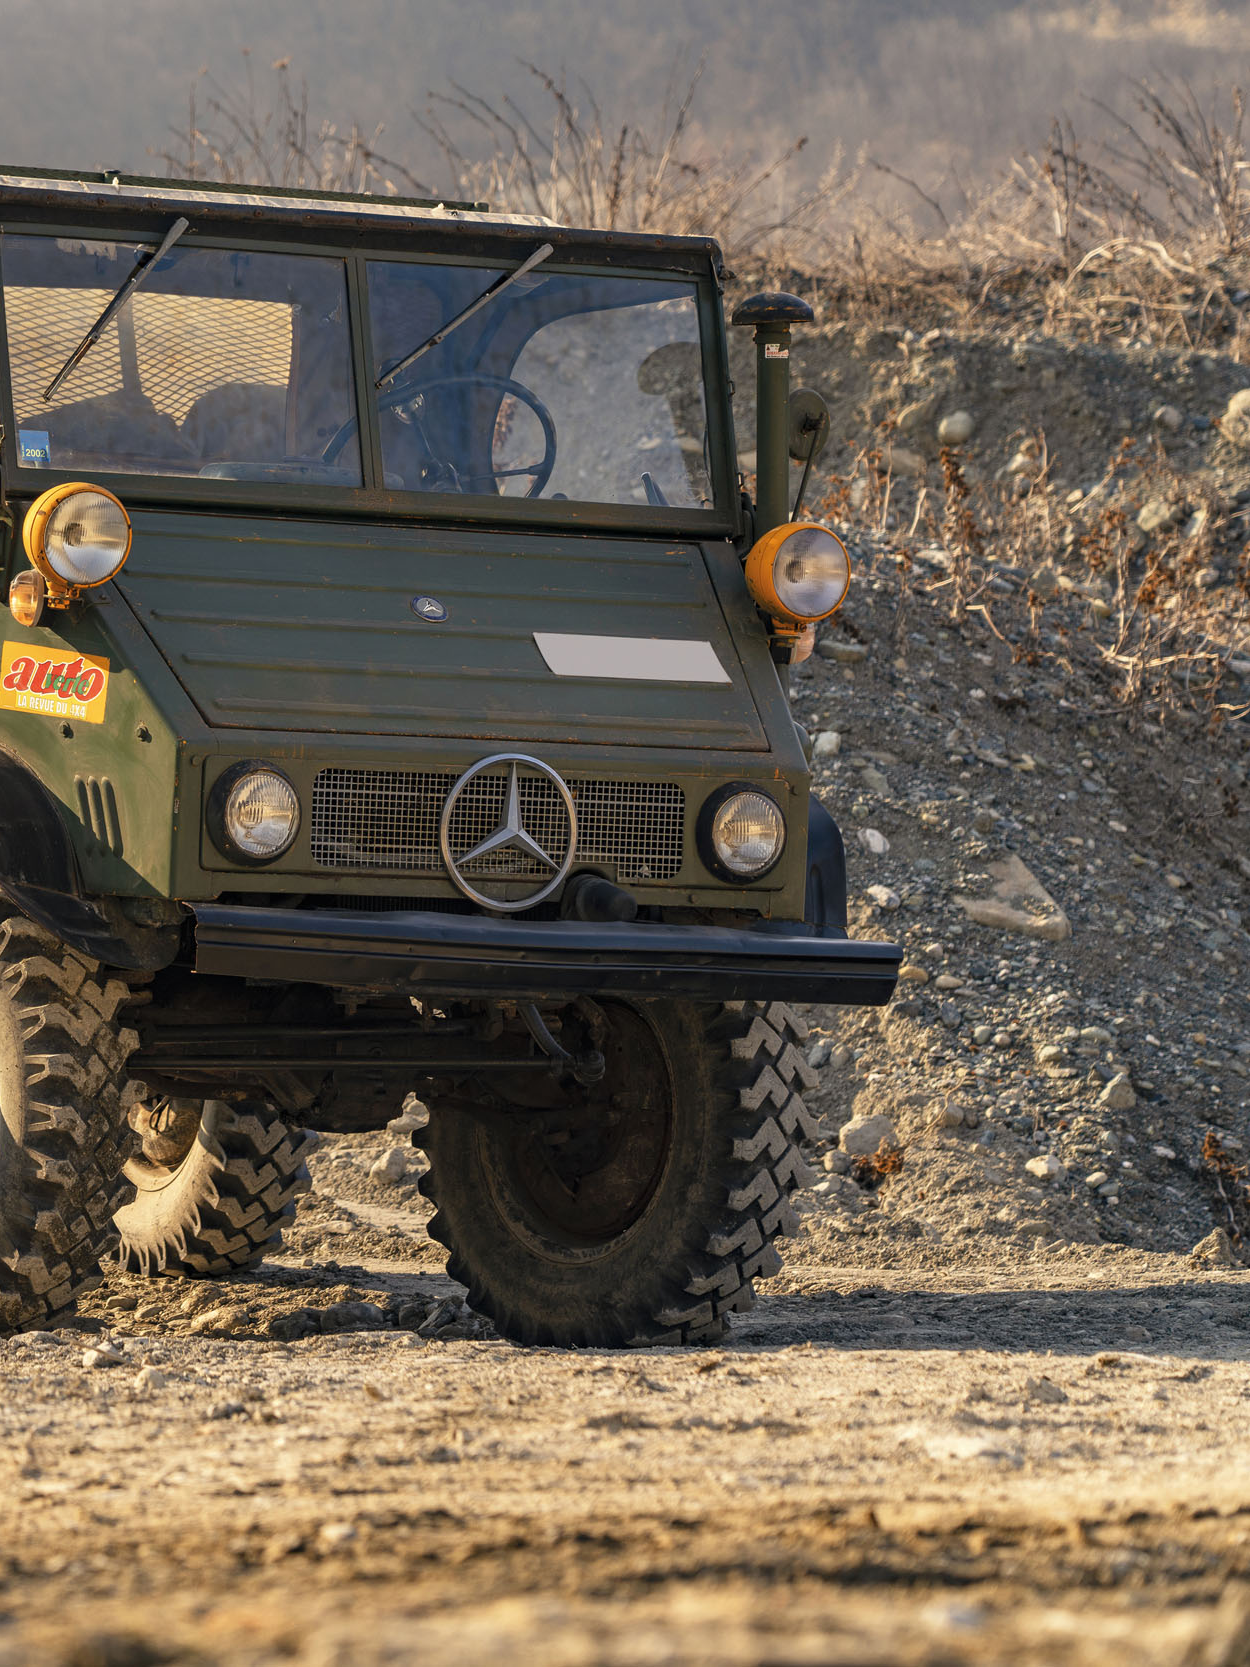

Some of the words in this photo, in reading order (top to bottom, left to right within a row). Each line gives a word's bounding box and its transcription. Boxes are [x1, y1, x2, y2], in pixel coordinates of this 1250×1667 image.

[25, 448, 46, 458] 2002
[3, 656, 105, 703] auto
[17, 694, 27, 707] LA
[29, 696, 54, 713] REVUE
[56, 701, 68, 715] DU
